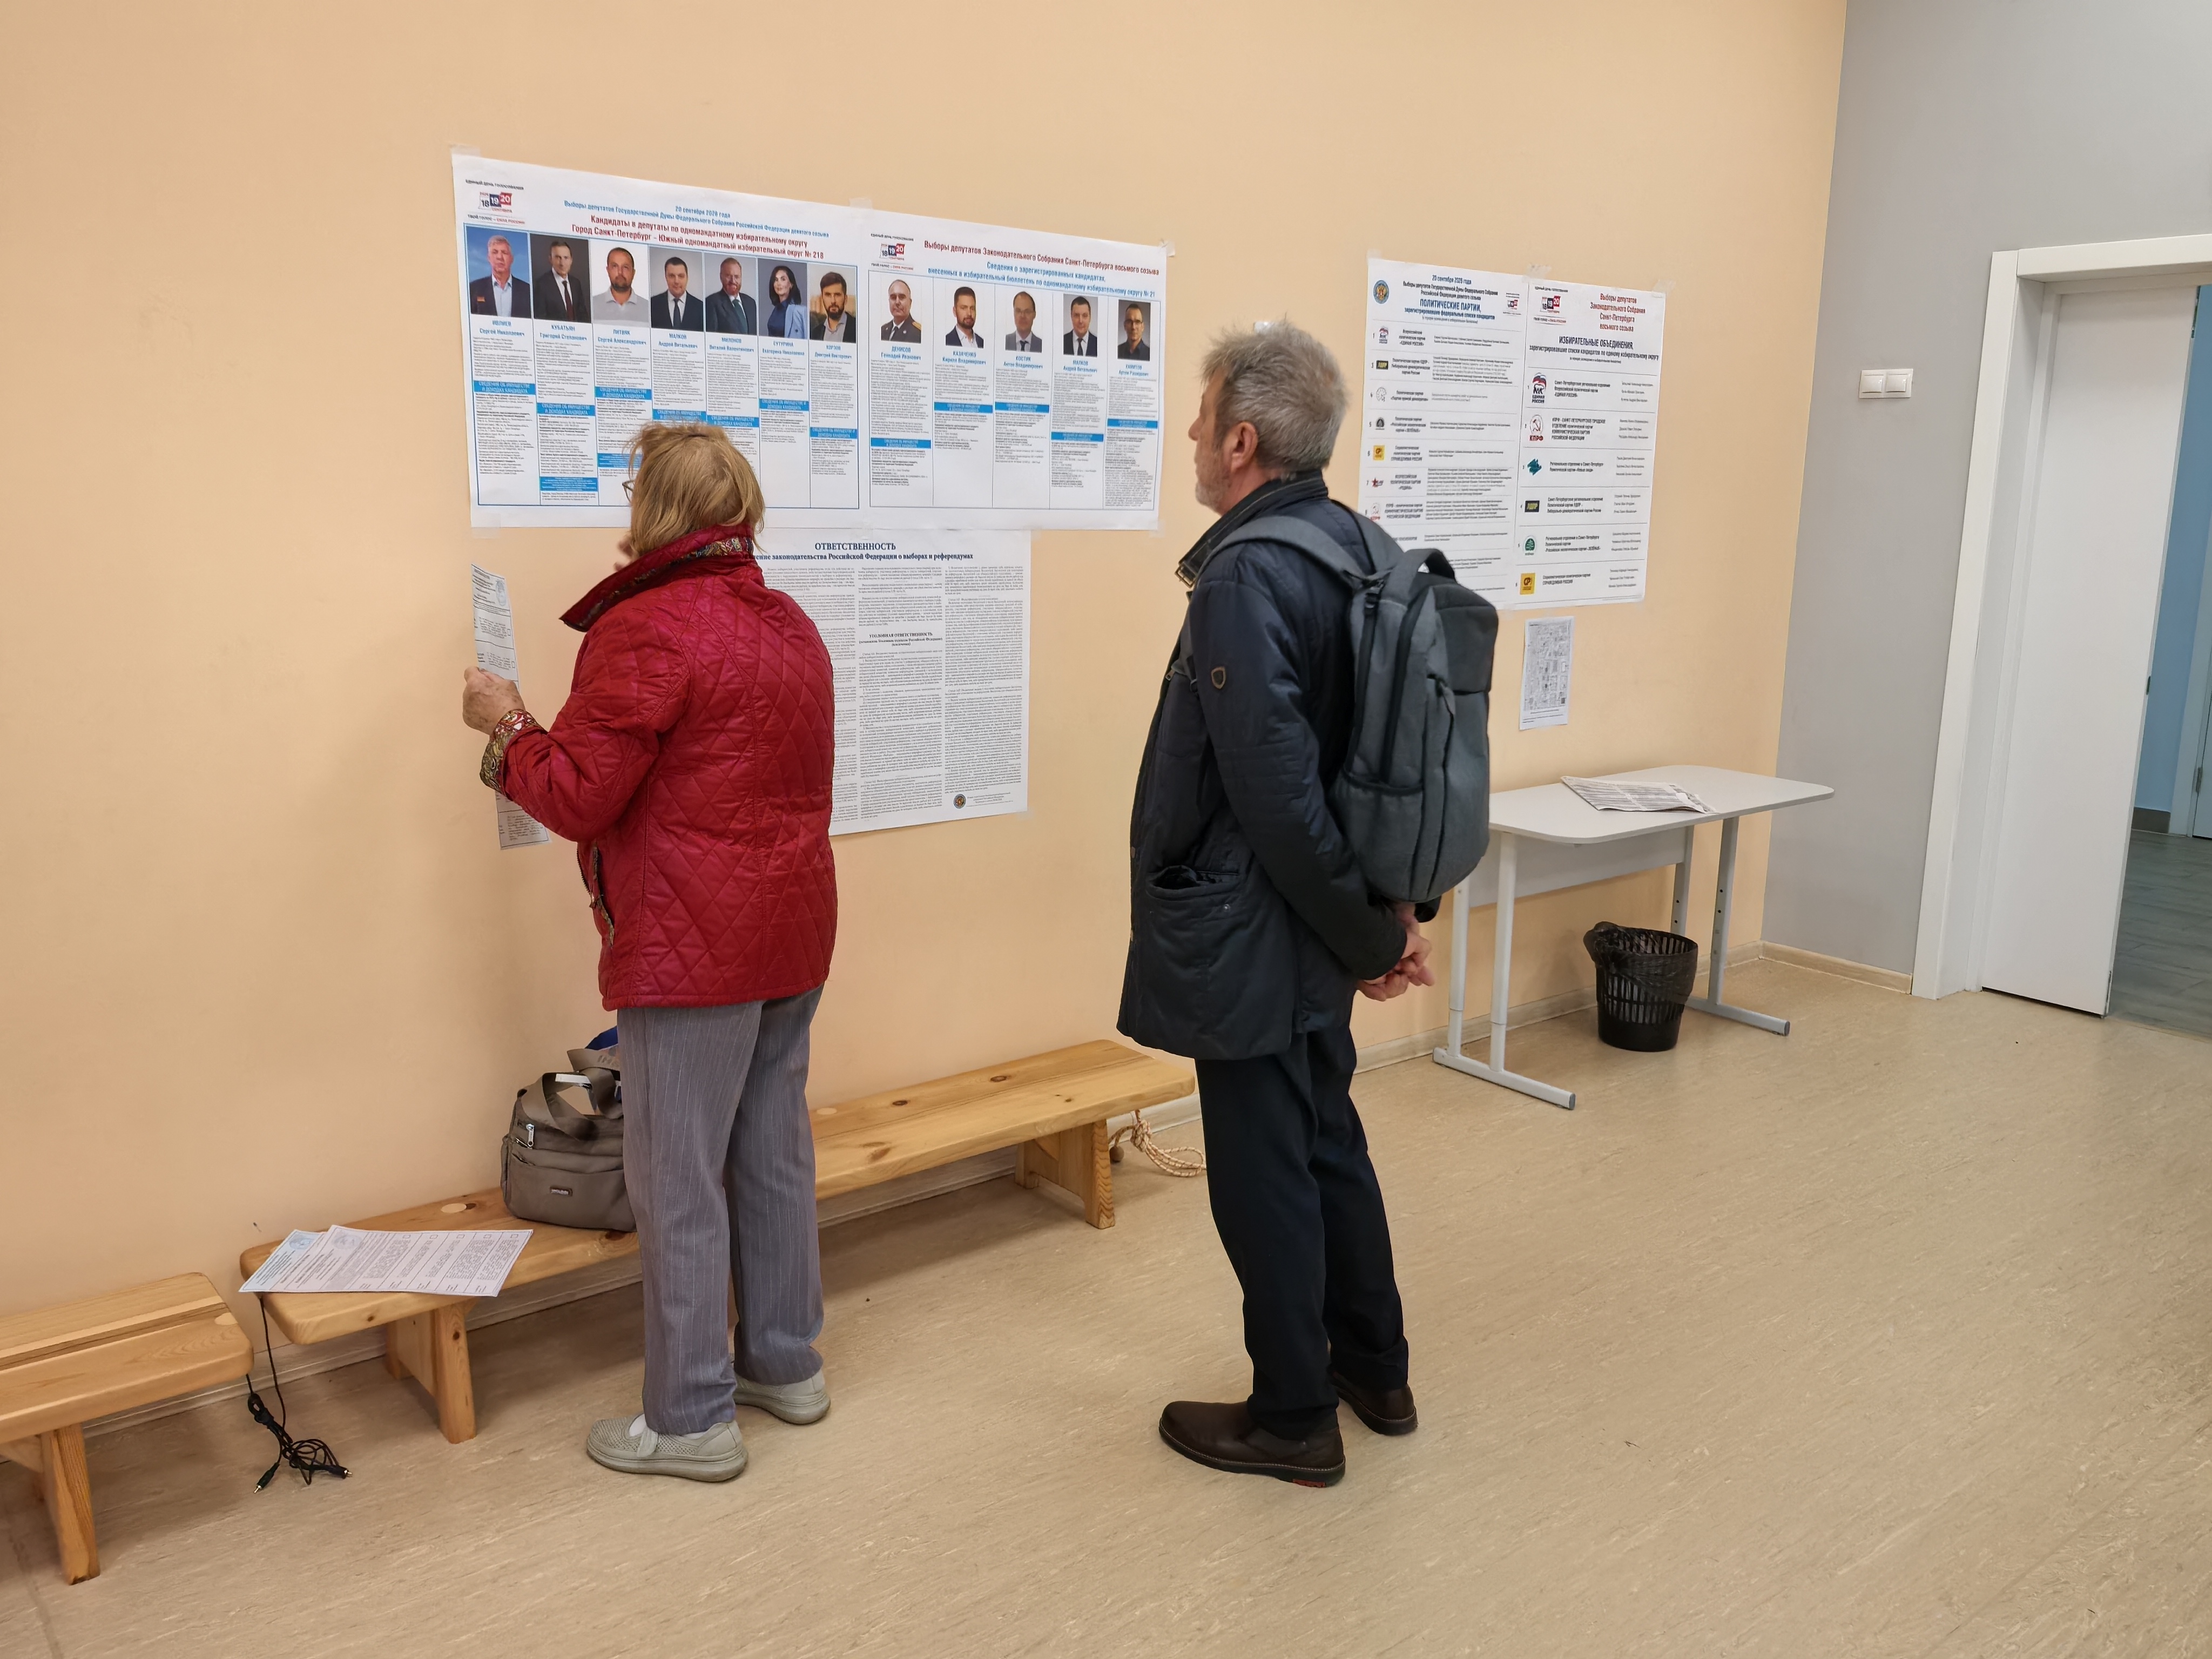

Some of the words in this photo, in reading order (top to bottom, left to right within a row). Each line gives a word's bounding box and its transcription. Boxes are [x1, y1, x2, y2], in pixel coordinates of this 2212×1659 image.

[481, 199, 489, 207] 18
[490, 197, 499, 205] 19
[501, 195, 510, 203] 20
[564, 200, 586, 209] Выборы
[588, 203, 615, 213] депутатов
[616, 206, 658, 218] Государственной
[676, 214, 711, 224] Федерального
[712, 219, 735, 227] Собрания
[736, 221, 763, 230] Российской
[764, 225, 790, 233] Федерации
[683, 207, 705, 215] сентября
[591, 215, 630, 227] Кандидаты
[638, 221, 669, 232] депутаты
[680, 227, 734, 240] одномандатному
[736, 233, 787, 245] избирательному
[788, 239, 808, 248] округу
[572, 225, 592, 234] Город
[595, 227, 651, 241] Санкт-Петербург
[658, 234, 683, 245] Южный
[685, 238, 736, 250] одномандатный
[738, 245, 786, 255] избирательный
[924, 240, 949, 251] Выборы
[950, 244, 981, 255] депутатов
[982, 247, 1036, 261] Законодательного
[1037, 254, 1063, 265] Собрания
[1065, 258, 1114, 271] Санкт-Петербурга
[1115, 265, 1139, 273] восьмого
[987, 261, 1013, 272] Сведения
[1019, 267, 1074, 279] зарегистрированных
[1075, 272, 1105, 282] кандидатах,
[928, 268, 957, 276] внесенных
[963, 271, 1006, 282] избирательный
[1007, 275, 1035, 285] бюллетень
[1043, 280, 1085, 292] одномандатному
[1087, 284, 1126, 296] избирательному
[1128, 289, 1143, 298] округу
[1600, 293, 1616, 302] Выборы
[1617, 296, 1637, 305] депутатов
[1420, 299, 1460, 309] ПОЛИТИЧЕСКИЕ
[1460, 302, 1481, 313] ПАРТИИ,
[1590, 302, 1626, 312] Законодательного
[1627, 306, 1645, 314] Собрания
[1600, 313, 1635, 323] Санкт-Петербурга
[1559, 336, 1599, 347] ИЗБИРАТЕЛЬНЫЕ
[815, 542, 896, 551] ОТВЕТСТВЕННОСТЬ
[865, 553, 898, 561] Федерации
[903, 552, 928, 561] выборах
[934, 552, 973, 561] референдумах
